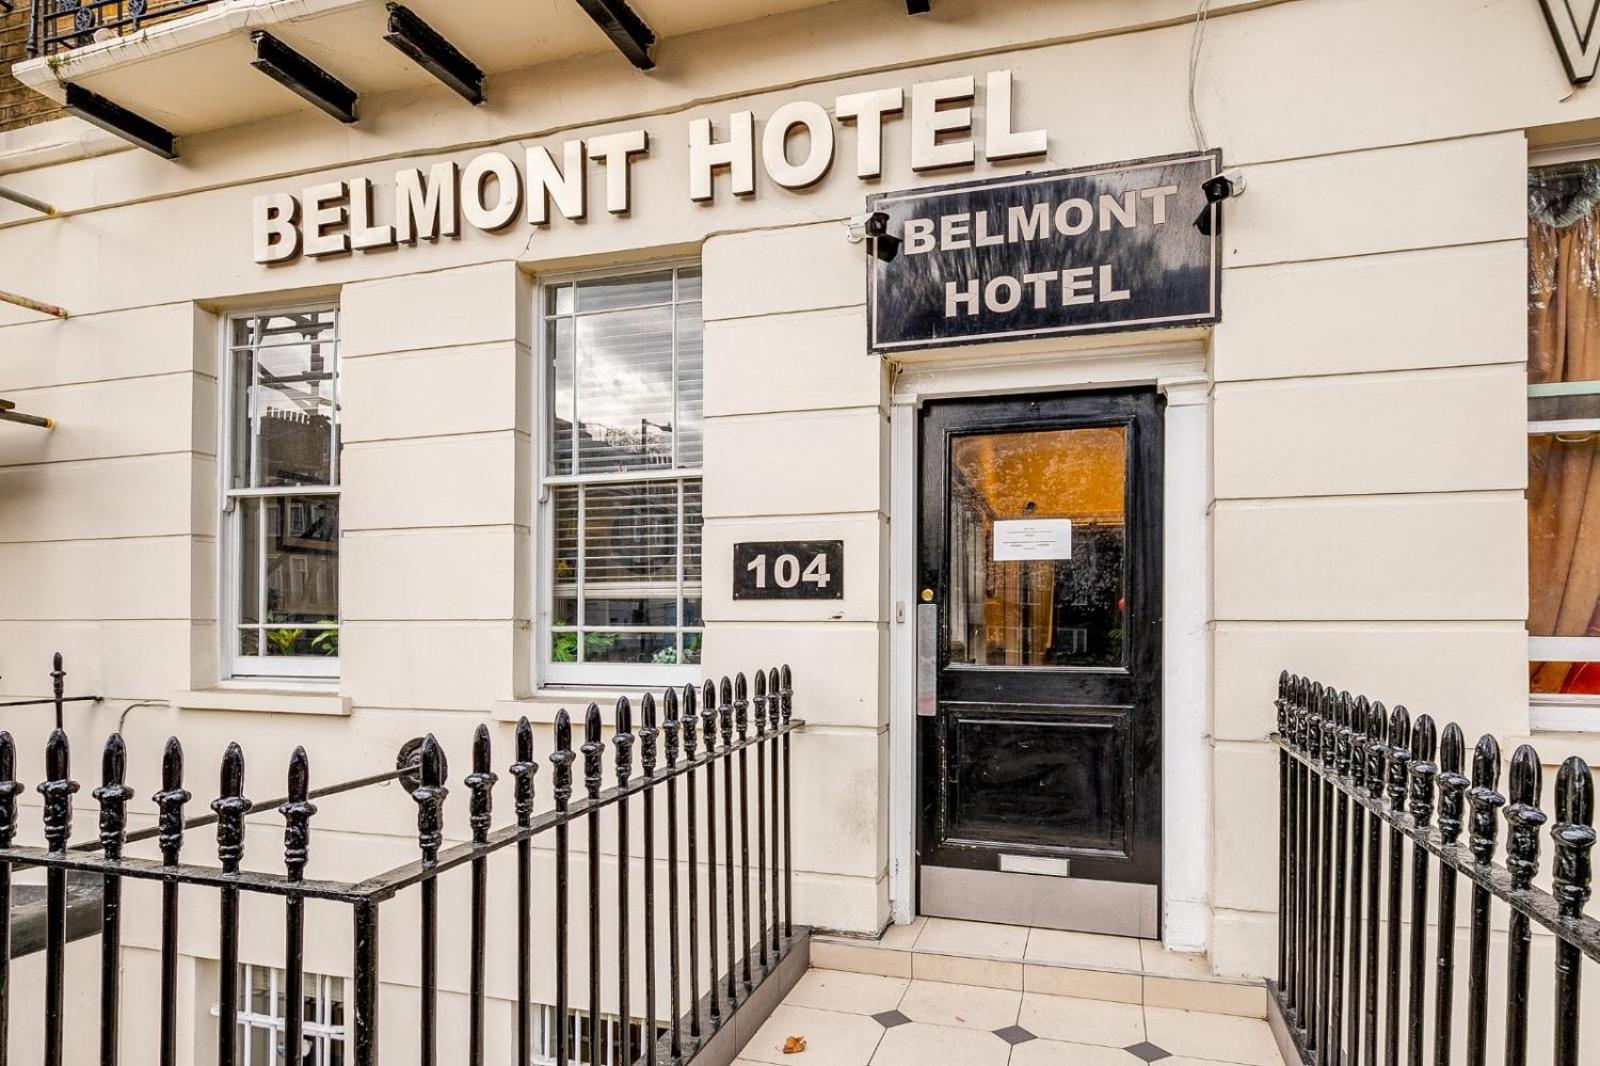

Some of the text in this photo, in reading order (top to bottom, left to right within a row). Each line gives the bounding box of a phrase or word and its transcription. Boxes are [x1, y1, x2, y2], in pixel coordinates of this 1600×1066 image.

[252, 69, 1049, 264] BELMONT HOTEL
[903, 184, 1179, 256] BELMONT
[944, 263, 1131, 319] HOTEL
[746, 552, 831, 589] 104
